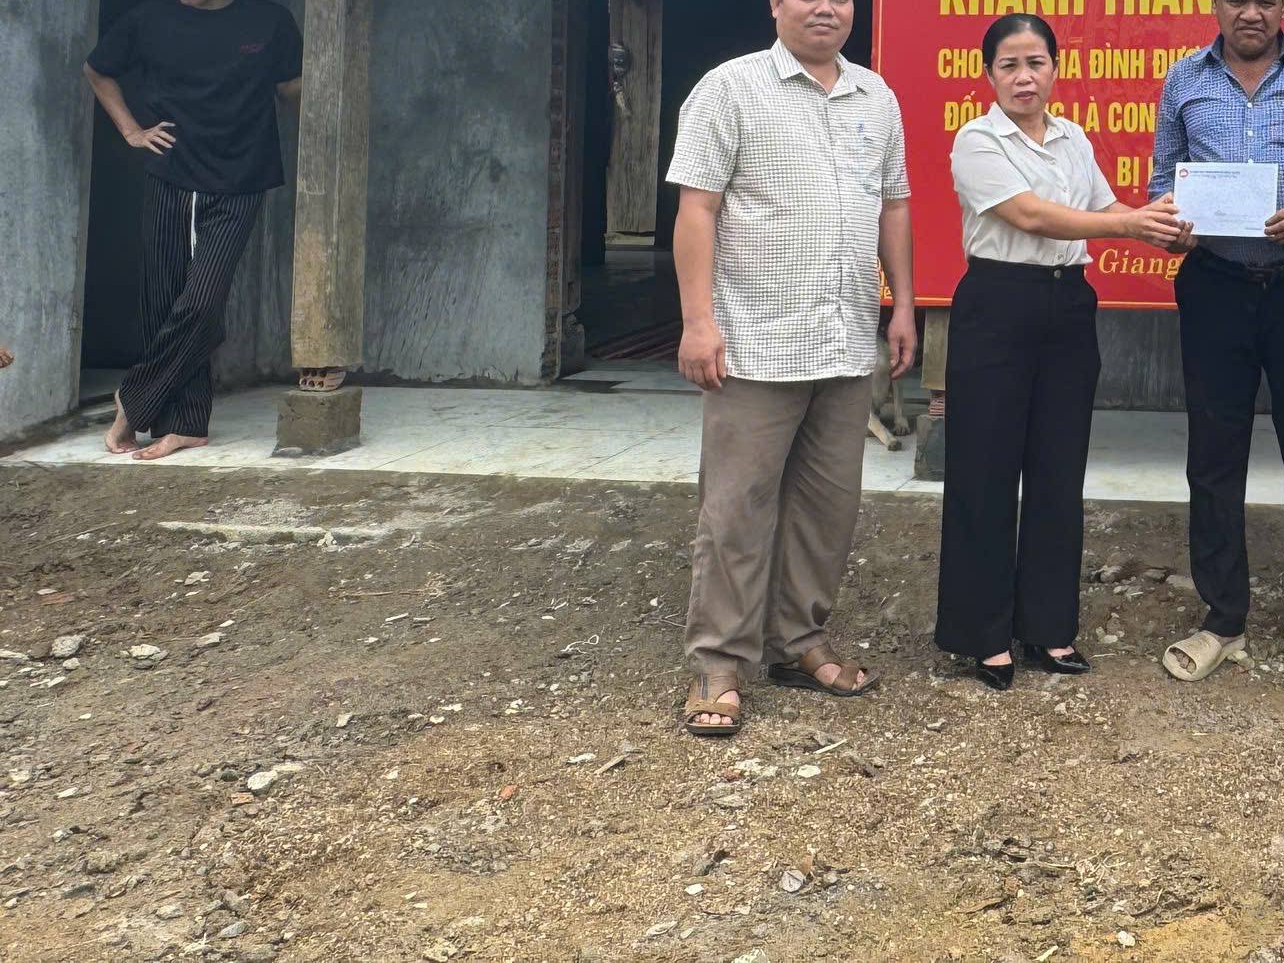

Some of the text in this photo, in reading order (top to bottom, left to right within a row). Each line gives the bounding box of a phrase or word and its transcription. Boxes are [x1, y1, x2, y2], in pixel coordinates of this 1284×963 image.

[938, 48, 984, 79] CHO
[1089, 42, 1145, 79] ĐÌNH
[1108, 102, 1157, 133] CON
[1117, 156, 1140, 194] BỊ
